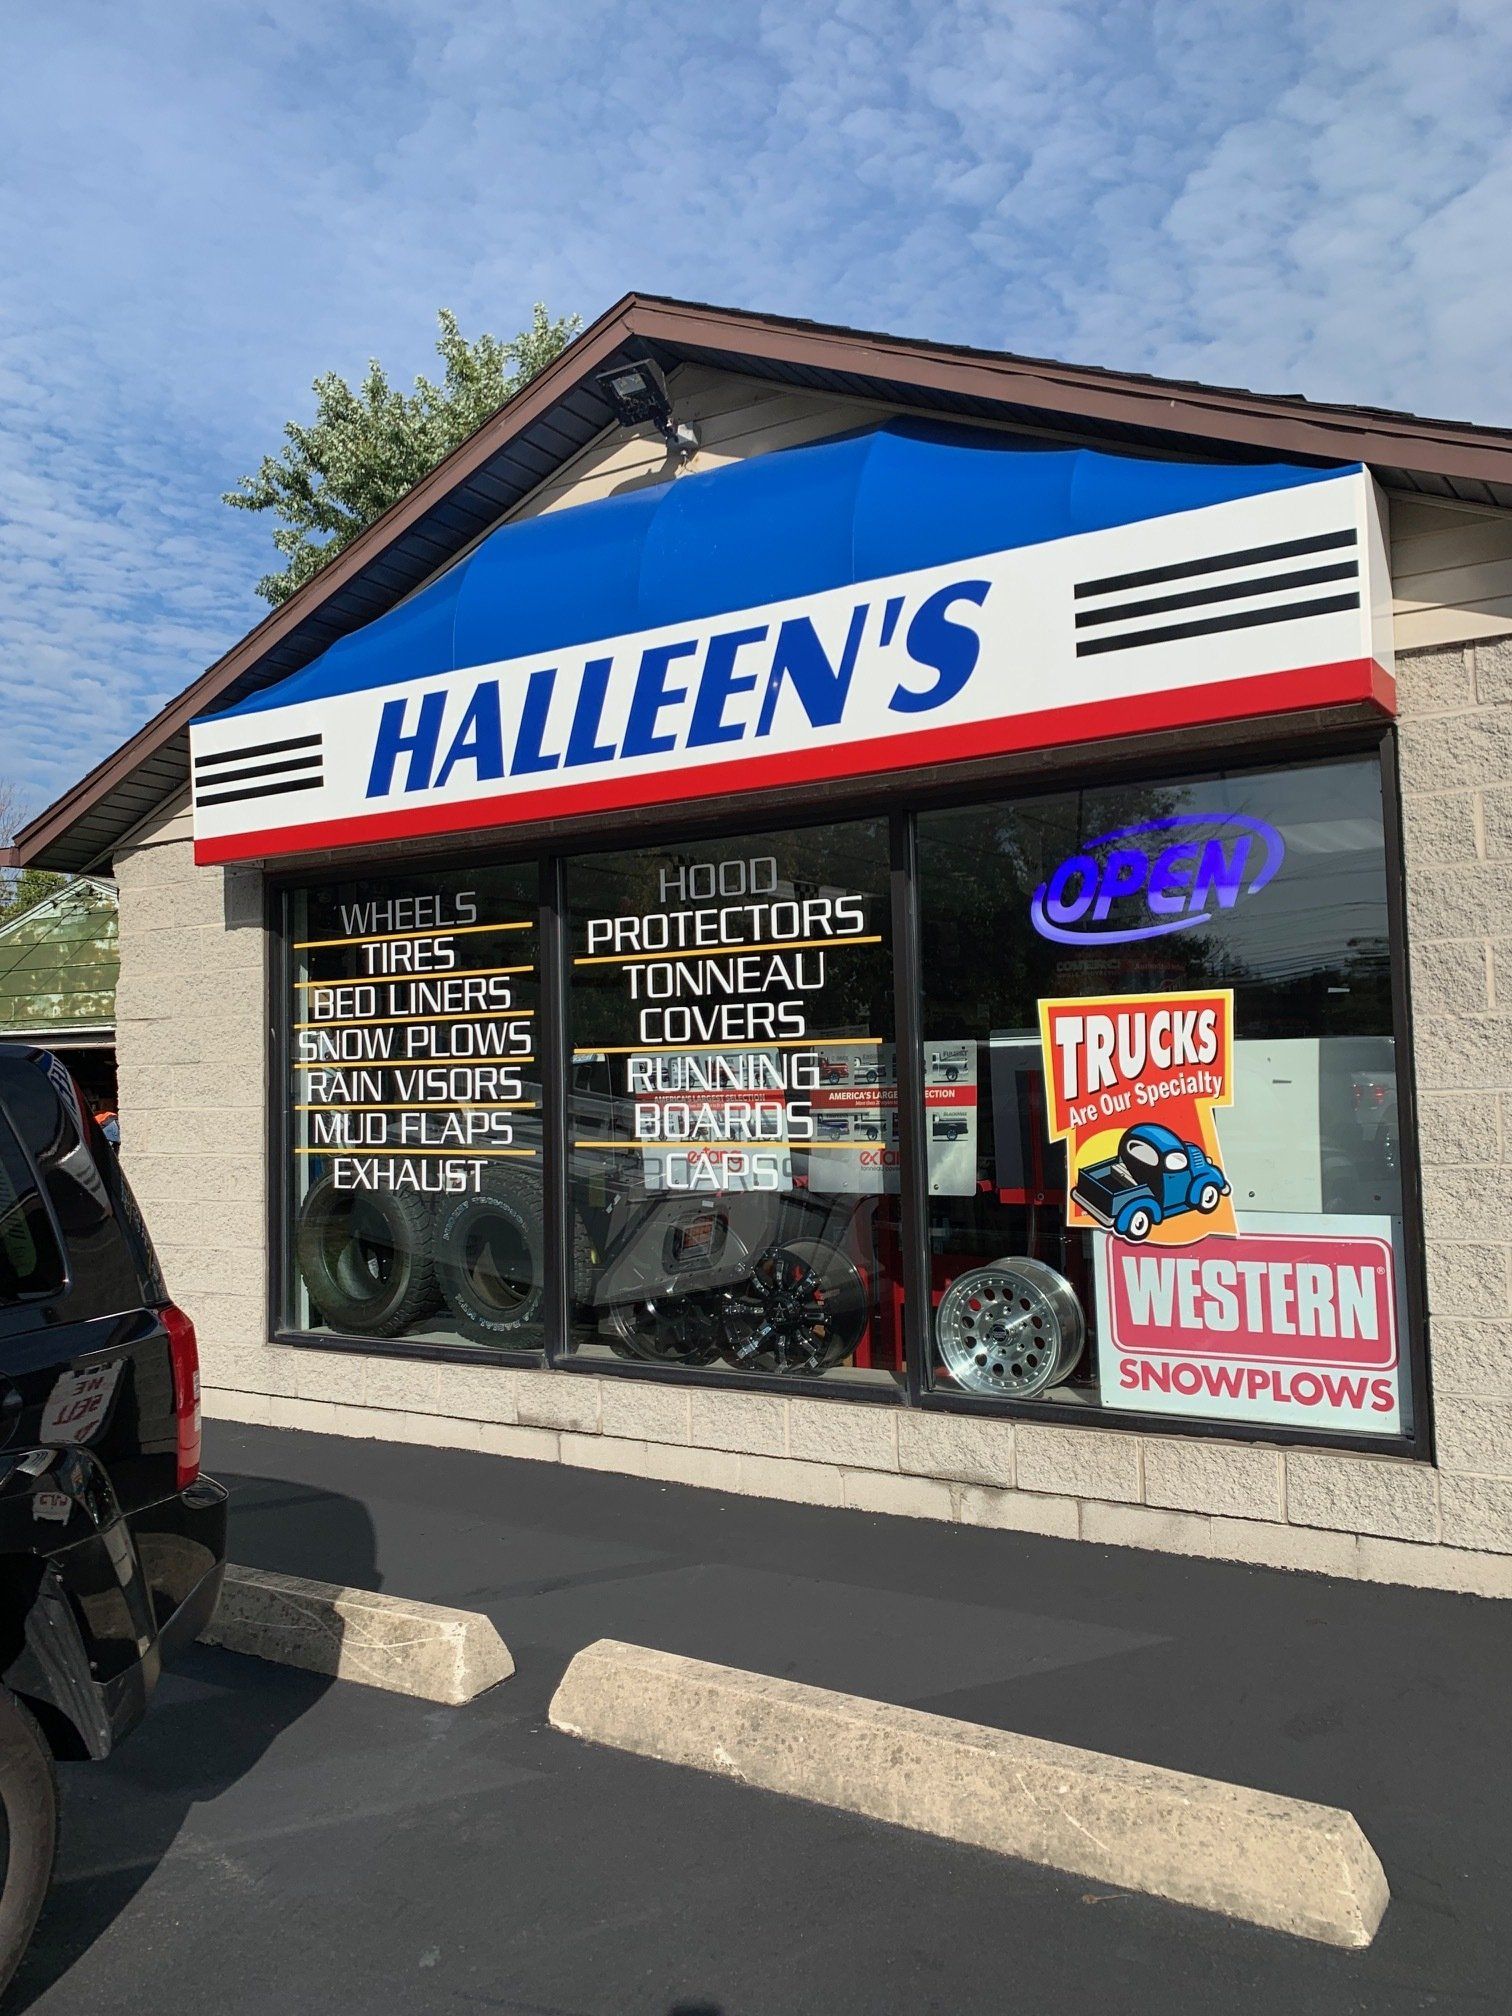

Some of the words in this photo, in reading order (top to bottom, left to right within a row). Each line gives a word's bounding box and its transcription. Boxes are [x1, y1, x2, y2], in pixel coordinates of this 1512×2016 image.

[366, 579, 992, 799] HALLEEN'S
[660, 857, 778, 902] HOOD
[1046, 835, 1252, 923] OPEN
[341, 891, 477, 934] WHEELS
[587, 895, 864, 954] PROTECTORS
[362, 937, 455, 974] TIRES
[622, 952, 824, 999] TONNEAU
[314, 985, 375, 1020] BED
[390, 976, 511, 1015] LINERS
[299, 1028, 393, 1061] SNOW
[407, 1021, 531, 1058] PLOWS
[640, 1001, 805, 1043] COVERS
[627, 1053, 820, 1092] RUNNING
[1055, 1008, 1218, 1100] TRUCKS
[307, 1070, 382, 1102] RAIN
[395, 1067, 522, 1101] VISORS
[725, 1093, 765, 1102] SELECTION
[829, 1091, 871, 1101] AMERICA'S
[872, 1090, 898, 1099] LARGE
[925, 1089, 956, 1098] ECTION
[1069, 1104, 1098, 1130] Are
[1101, 1090, 1131, 1116] Our
[1134, 1071, 1223, 1107] Specialty
[314, 1113, 387, 1144] MUD
[400, 1112, 512, 1145] FLAPS
[634, 1102, 813, 1138] BOARDS
[333, 1158, 488, 1193] EXHAUST
[666, 1153, 778, 1190] CAPS
[1119, 1358, 1395, 1412] SNOWPLOWS
